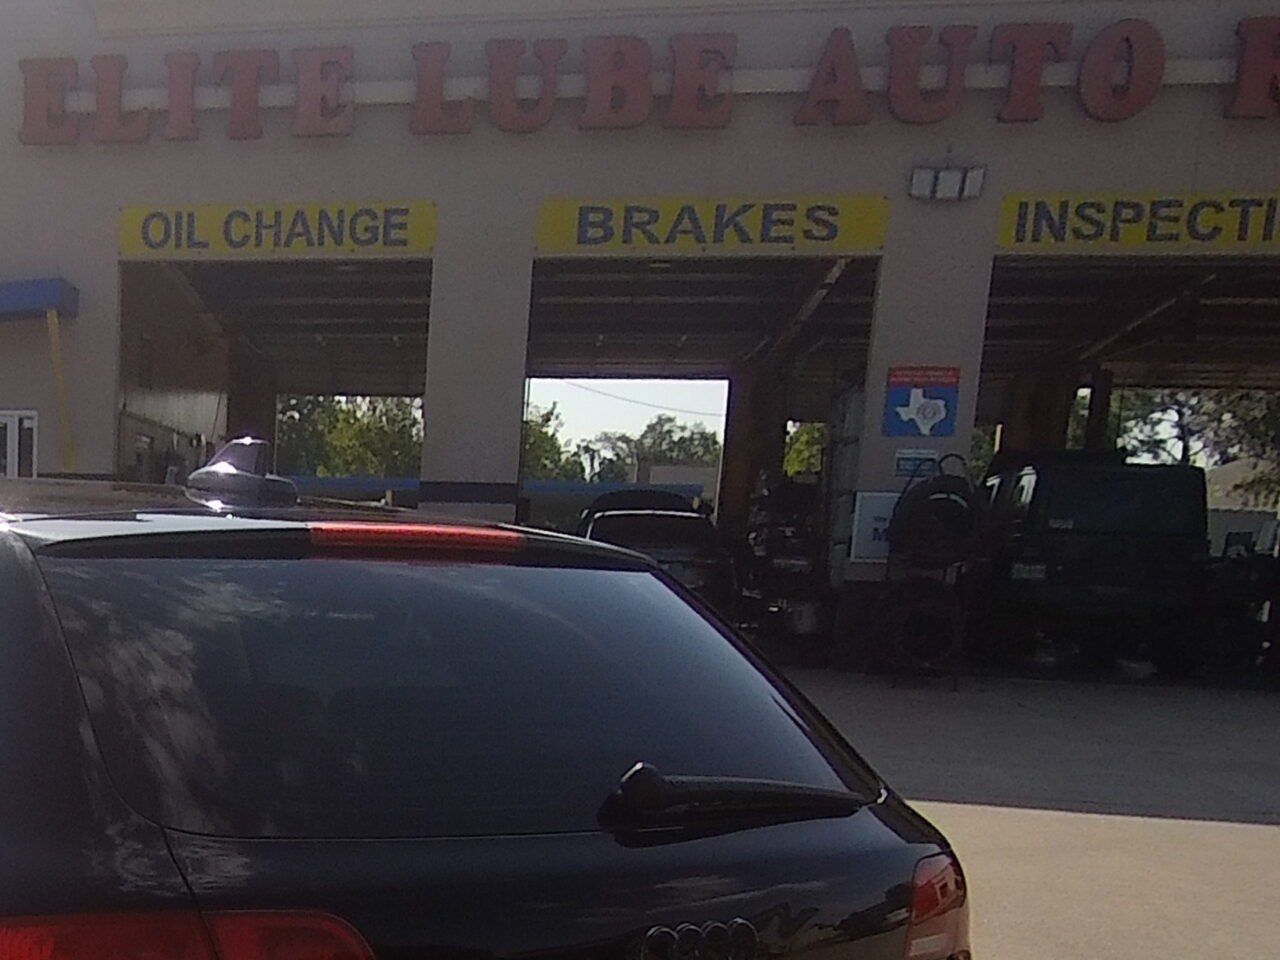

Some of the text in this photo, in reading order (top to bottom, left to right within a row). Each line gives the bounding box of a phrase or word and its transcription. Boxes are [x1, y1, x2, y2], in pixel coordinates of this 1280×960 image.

[19, 45, 354, 144] ELITE
[408, 33, 739, 136] LUBE
[793, 18, 1165, 127] AUTO
[140, 205, 410, 250] OIL CHANGE
[575, 201, 841, 246] BRAKES
[1013, 197, 1280, 244] INSPECTI
